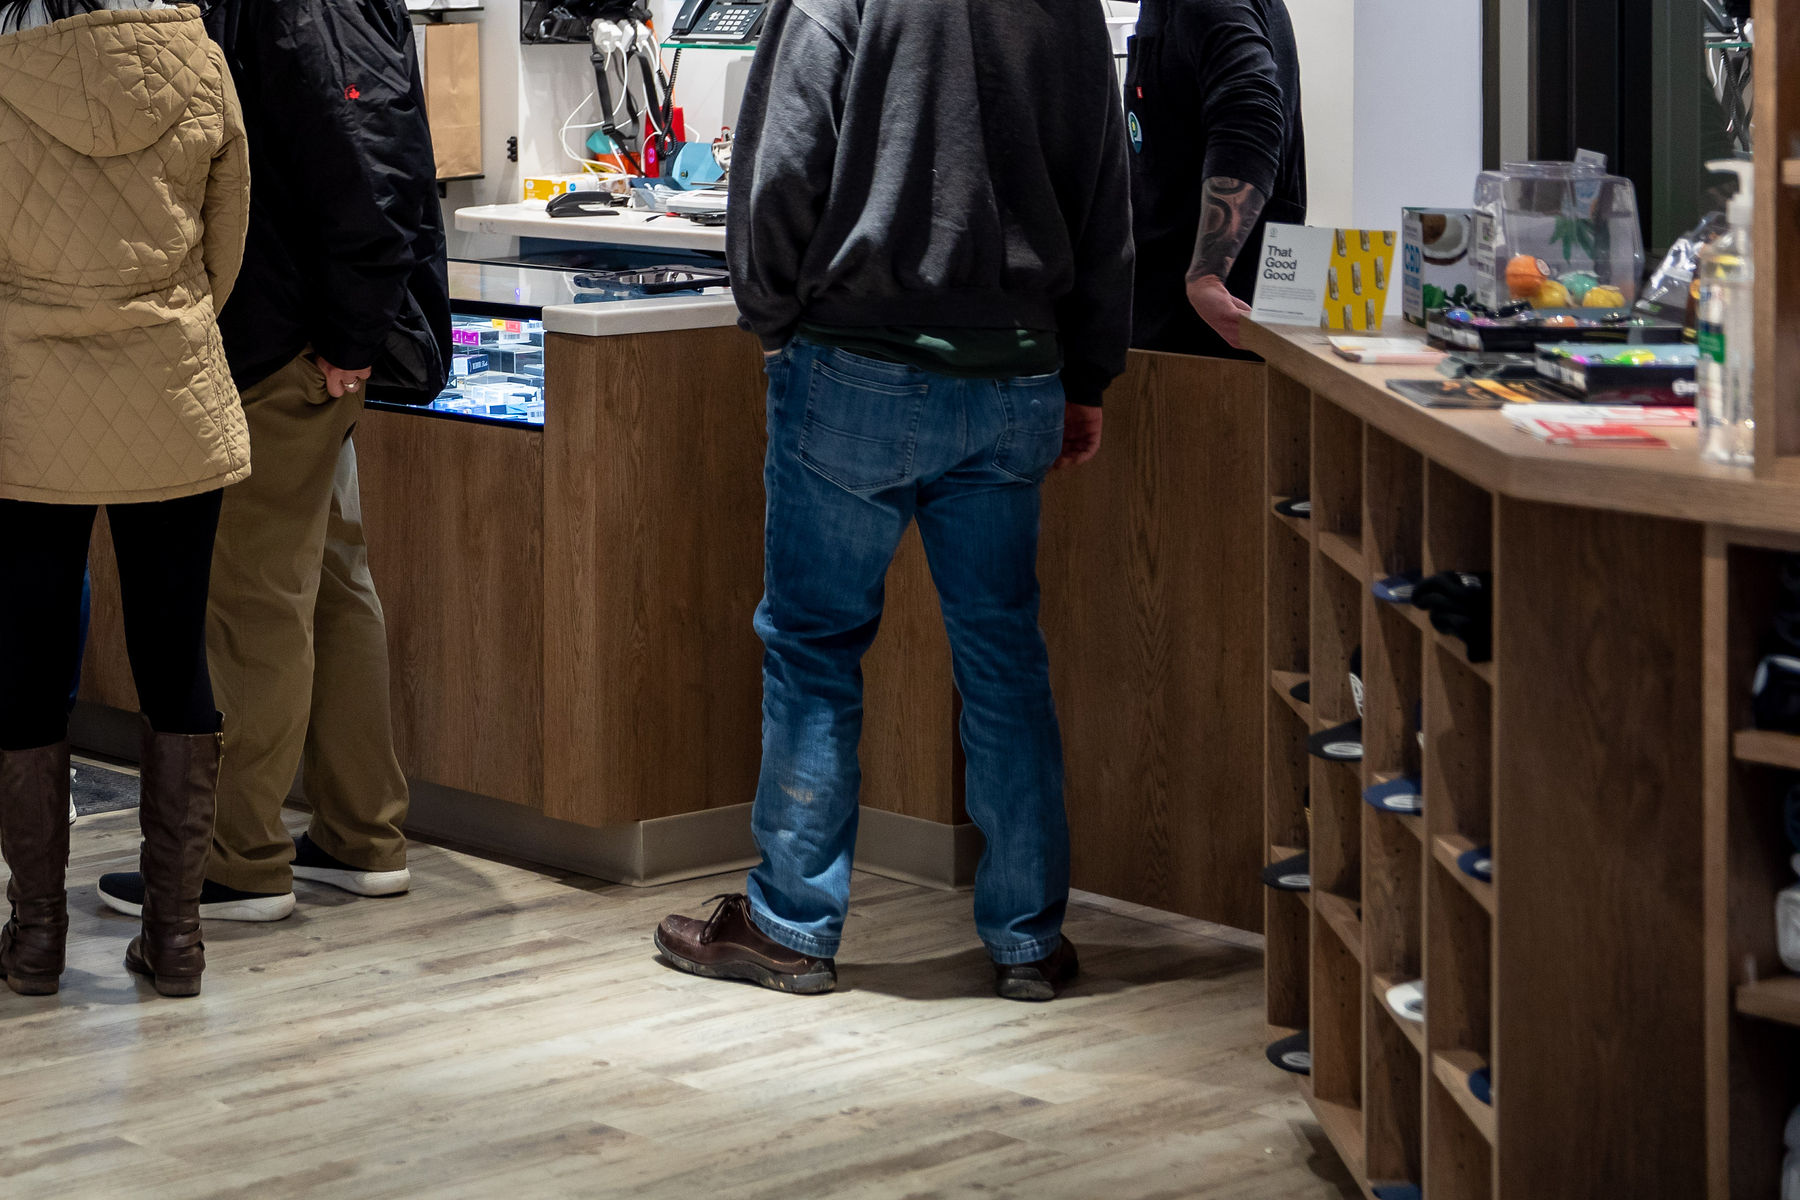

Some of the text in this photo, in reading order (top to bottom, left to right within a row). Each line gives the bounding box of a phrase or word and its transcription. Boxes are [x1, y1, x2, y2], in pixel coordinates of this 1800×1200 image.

[1268, 245, 1292, 257] That
[1265, 257, 1297, 269] Good
[1405, 243, 1420, 274] CBD
[1263, 269, 1295, 281] Good
